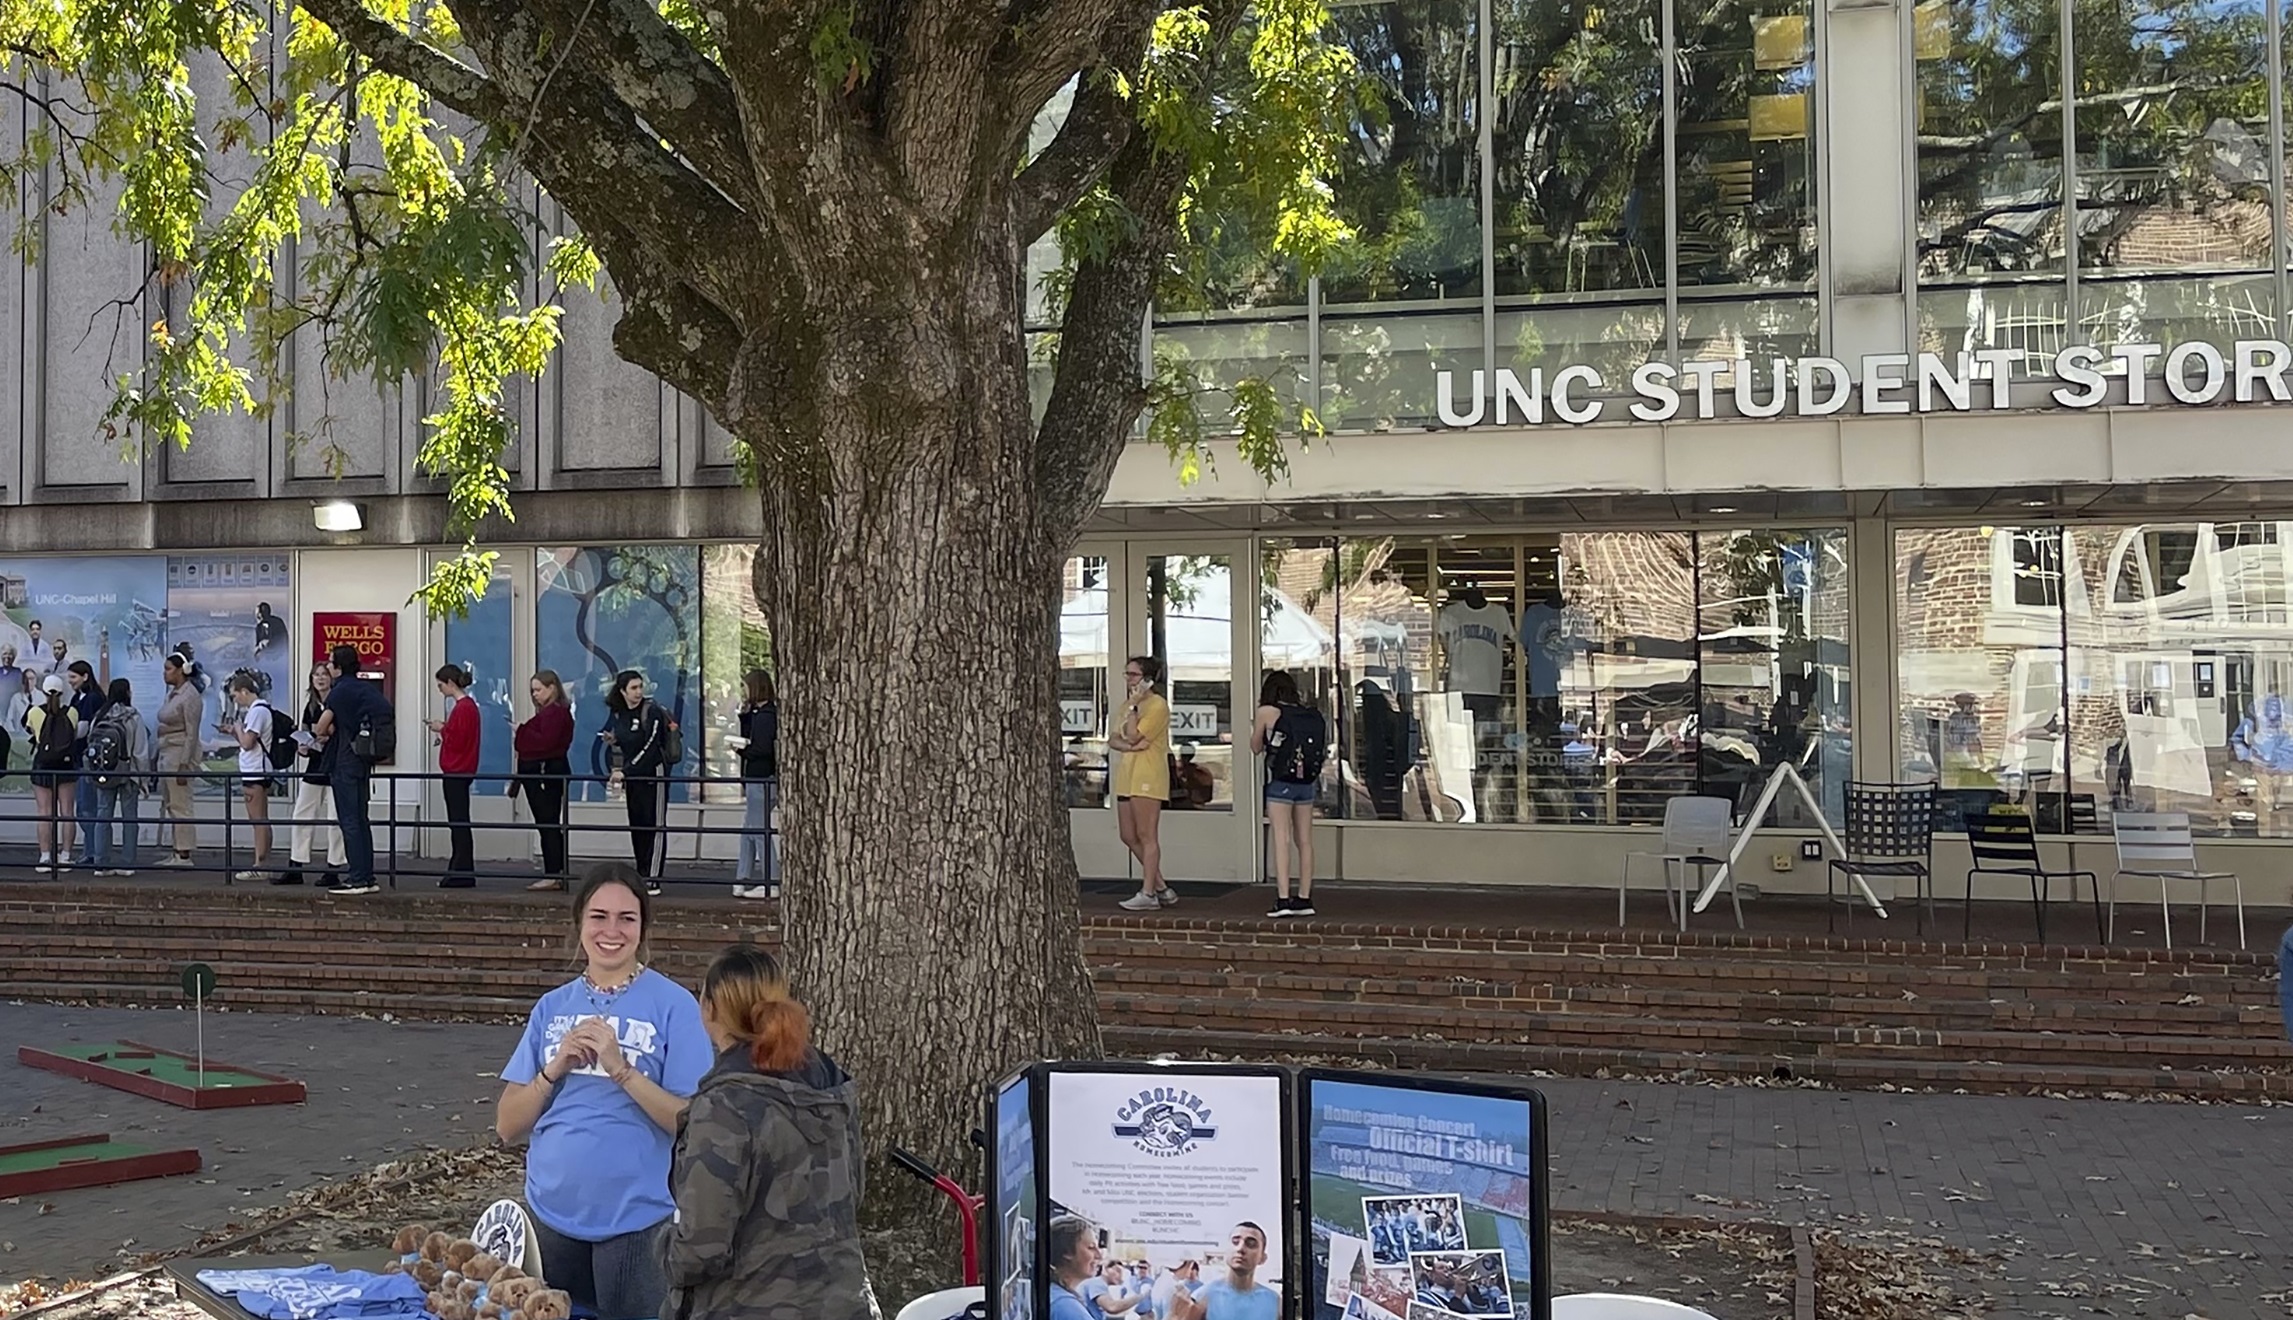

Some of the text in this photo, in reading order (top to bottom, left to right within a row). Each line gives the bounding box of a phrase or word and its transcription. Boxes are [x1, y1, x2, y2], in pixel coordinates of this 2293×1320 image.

[1436, 364, 1605, 427] UNC
[1628, 349, 2024, 422] STUDENT
[35, 592, 117, 606] UNC-Chapel Hill
[323, 625, 385, 639] WELLS
[324, 641, 384, 655] FGO
[1059, 708, 1092, 725] XIT
[1169, 711, 1215, 729] EXIT
[1117, 1087, 1212, 1124] CAROLINA
[1323, 1104, 1476, 1137] Homecoming Concert
[1132, 1139, 1199, 1158] HOMECOMING
[1369, 1126, 1514, 1166] Official T-shirt
[1330, 1144, 1362, 1164] Free
[1403, 1155, 1454, 1175] games
[1339, 1165, 1413, 1188] and prizes
